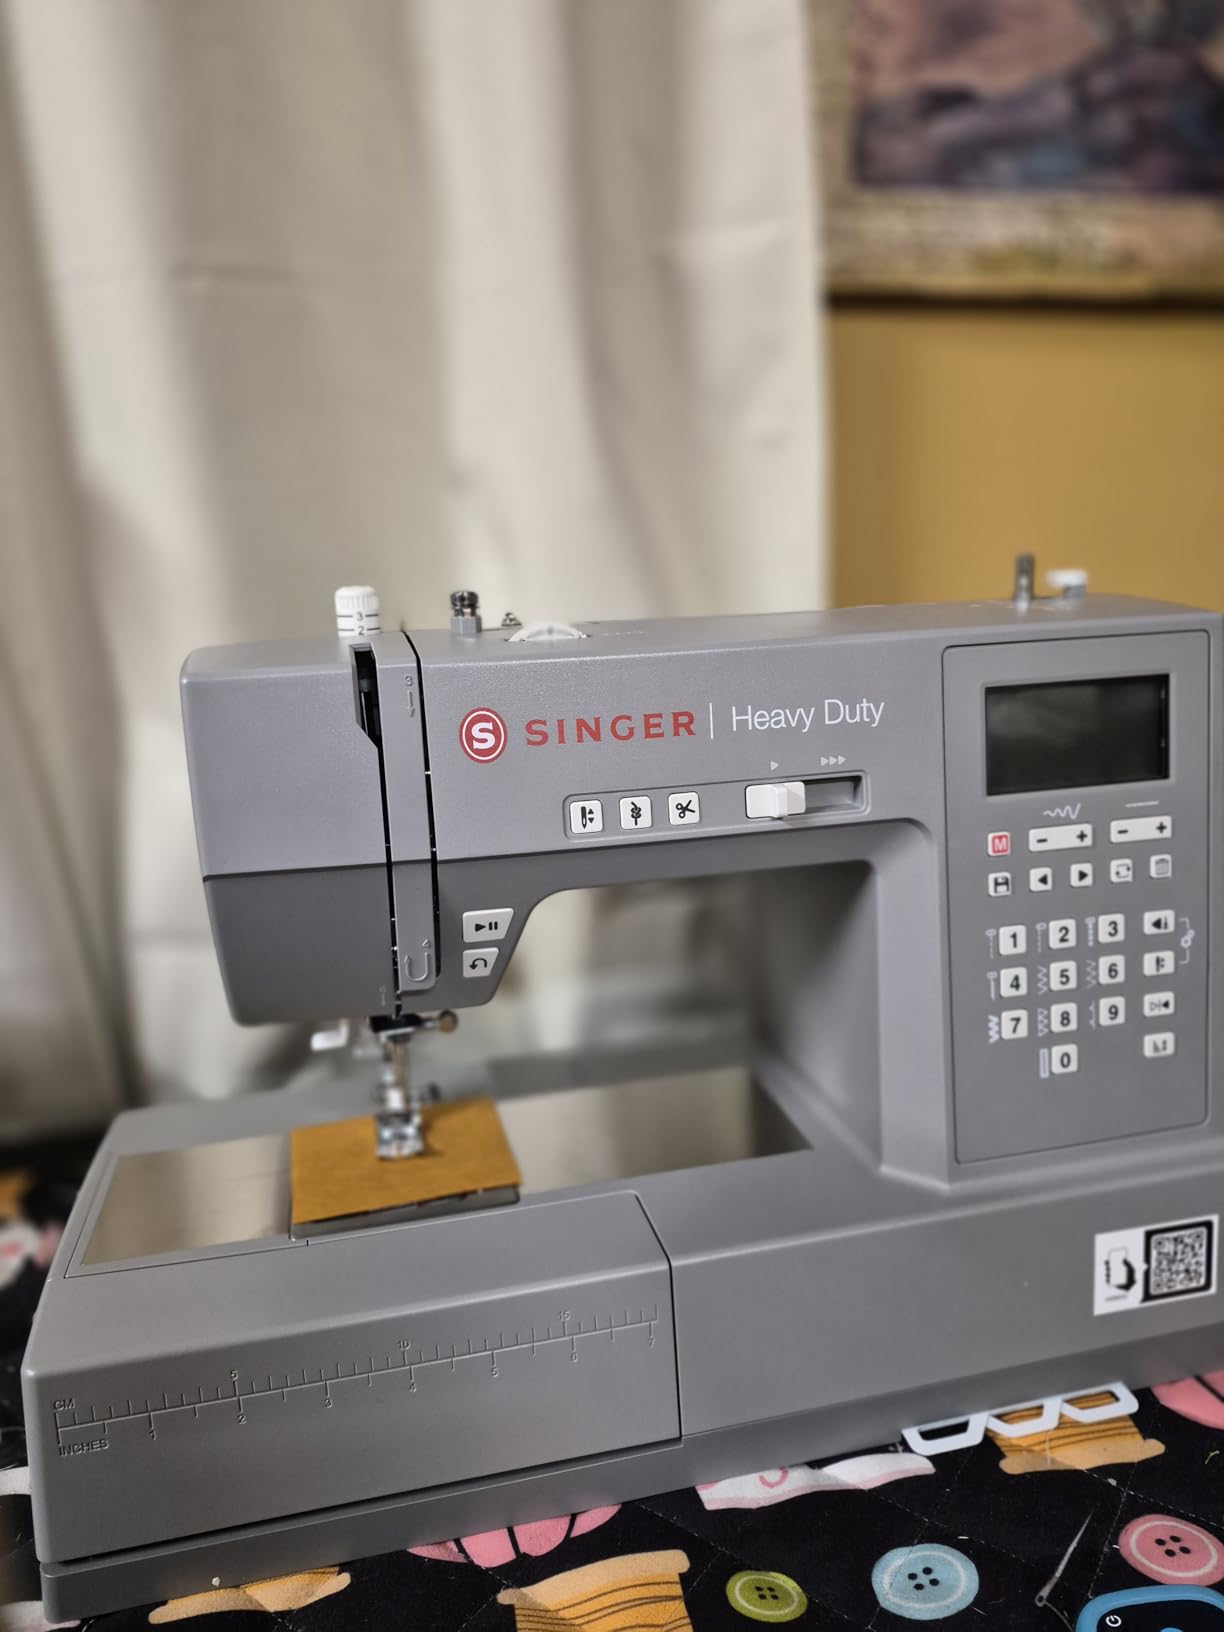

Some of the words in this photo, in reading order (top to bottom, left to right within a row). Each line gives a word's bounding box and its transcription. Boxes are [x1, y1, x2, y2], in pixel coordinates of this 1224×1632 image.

[356, 611, 364, 621] 3
[357, 625, 365, 636] 2
[404, 675, 413, 687] 3
[471, 722, 495, 749] S
[525, 710, 697, 747] SINGER
[731, 704, 816, 733] Heavy
[823, 697, 886, 728] Duty
[1009, 932, 1018, 949] 1
[1058, 926, 1070, 943] 2
[1107, 920, 1119, 937] 3
[1009, 974, 1021, 991] 4
[1059, 968, 1070, 985] 5
[1107, 962, 1119, 979] 6
[1009, 1017, 1021, 1034] 7
[1059, 1010, 1071, 1027] 8
[1107, 1004, 1119, 1021] 9
[1060, 1052, 1072, 1069] 0
[53, 1398, 76, 1411] CM
[230, 1369, 239, 1381] 5
[397, 1339, 411, 1351] 10
[559, 1310, 571, 1321] 15
[149, 1429, 157, 1441] 1
[238, 1414, 247, 1425] 2
[324, 1398, 333, 1409] 3
[408, 1382, 417, 1393] 4
[491, 1367, 499, 1378] 5
[570, 1351, 578, 1363] 6
[58, 1438, 110, 1457] INCHES
